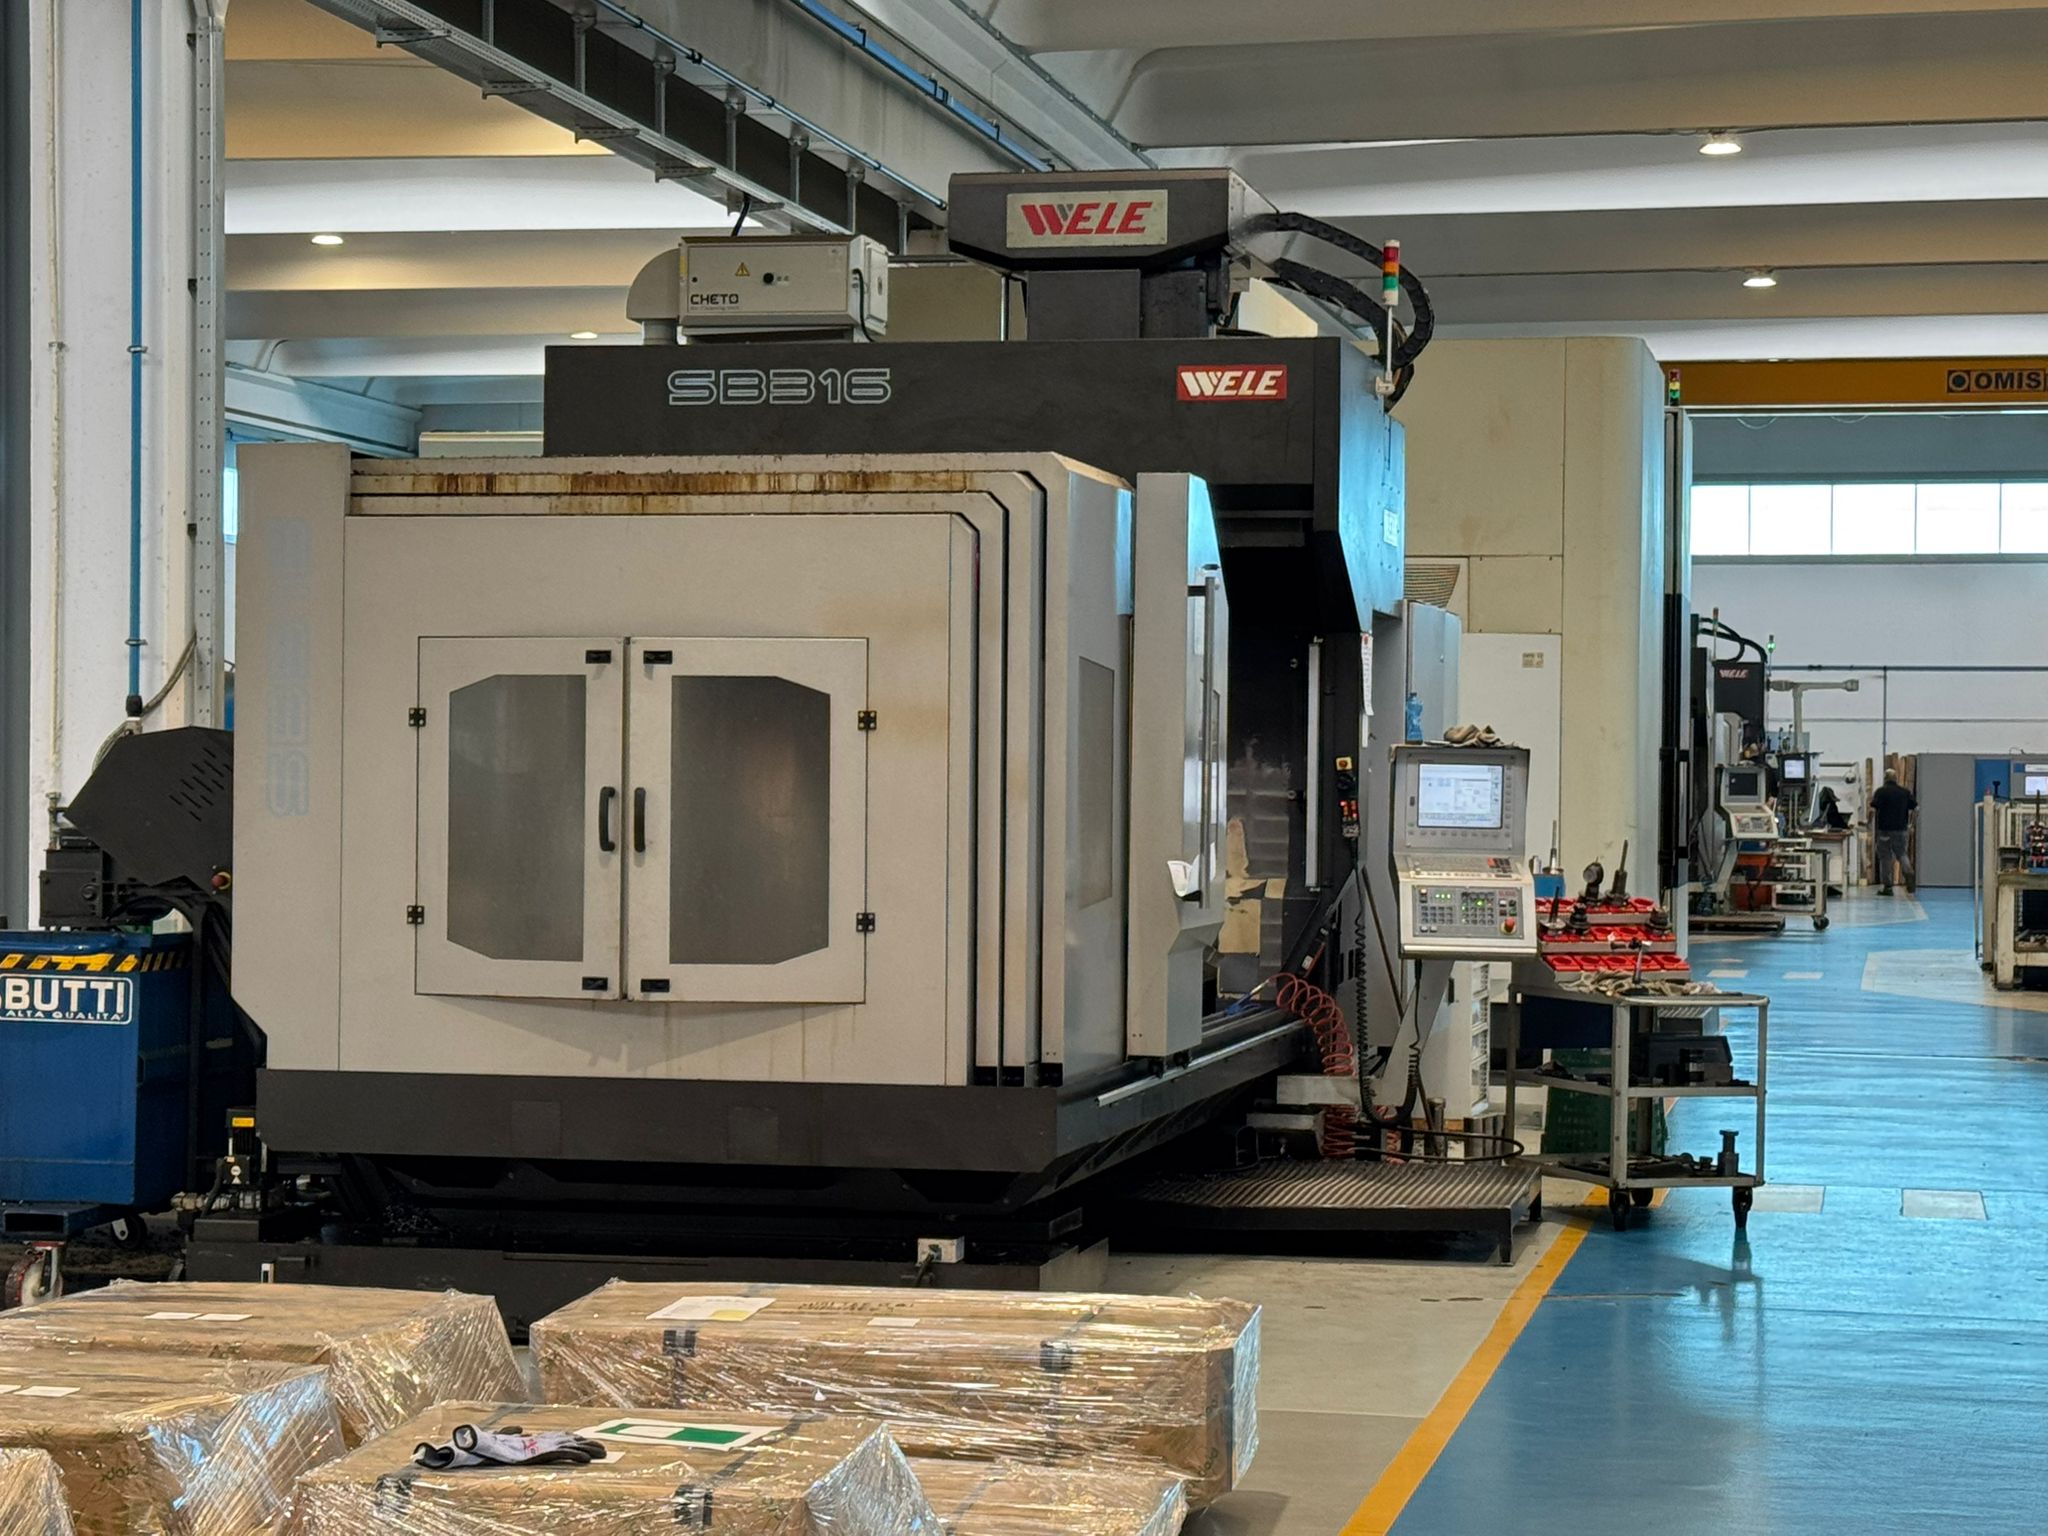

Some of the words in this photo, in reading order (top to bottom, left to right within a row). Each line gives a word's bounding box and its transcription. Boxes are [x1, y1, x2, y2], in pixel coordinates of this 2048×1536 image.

[1021, 202, 1153, 236] WELE
[690, 293, 739, 305] CHETO
[667, 368, 892, 405] SB316
[1180, 370, 1283, 397] WELE
[1974, 371, 2042, 390] OMIS
[5, 978, 125, 1014] BUTTI
[5, 1009, 45, 1019] ALTA
